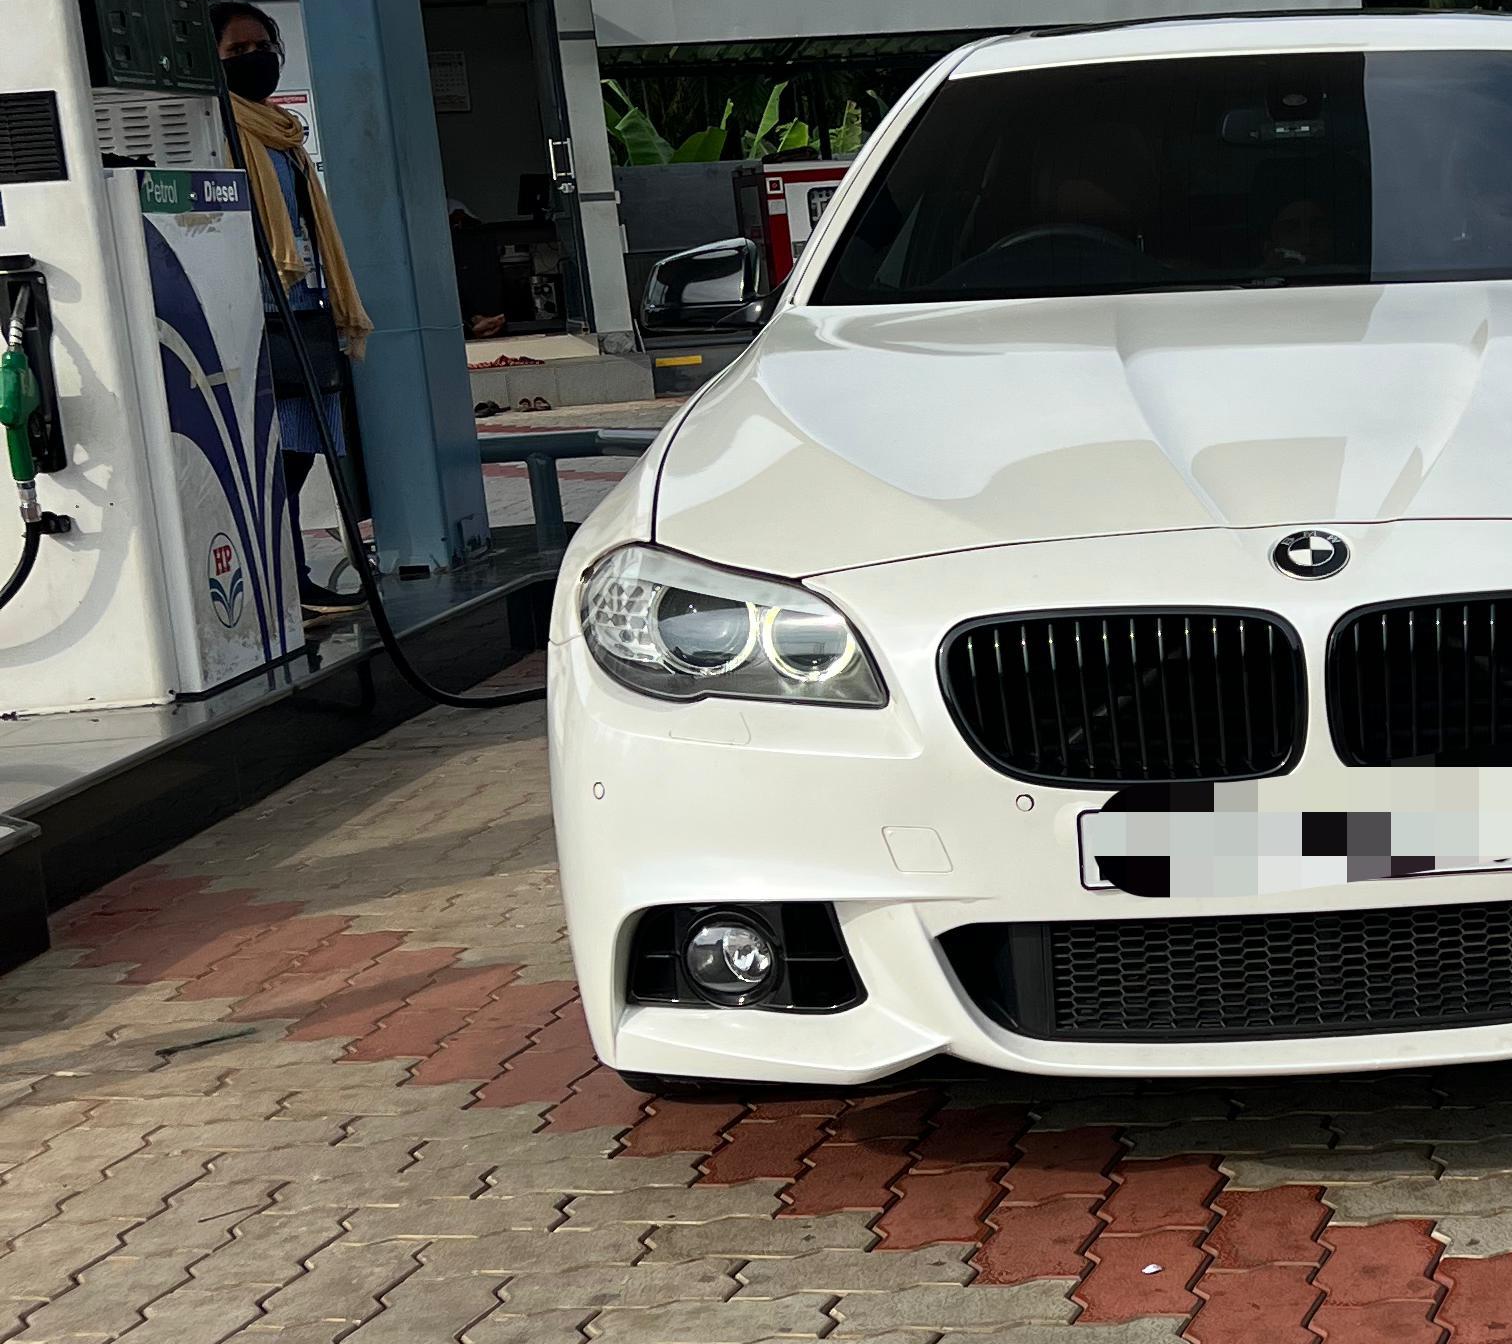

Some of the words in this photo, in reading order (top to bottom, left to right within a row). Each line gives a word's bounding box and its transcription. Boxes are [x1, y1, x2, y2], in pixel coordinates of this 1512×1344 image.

[145, 179, 178, 204] Petrol
[203, 180, 239, 203] Diesel
[1281, 530, 1341, 546] BMW
[213, 544, 232, 576] HP
